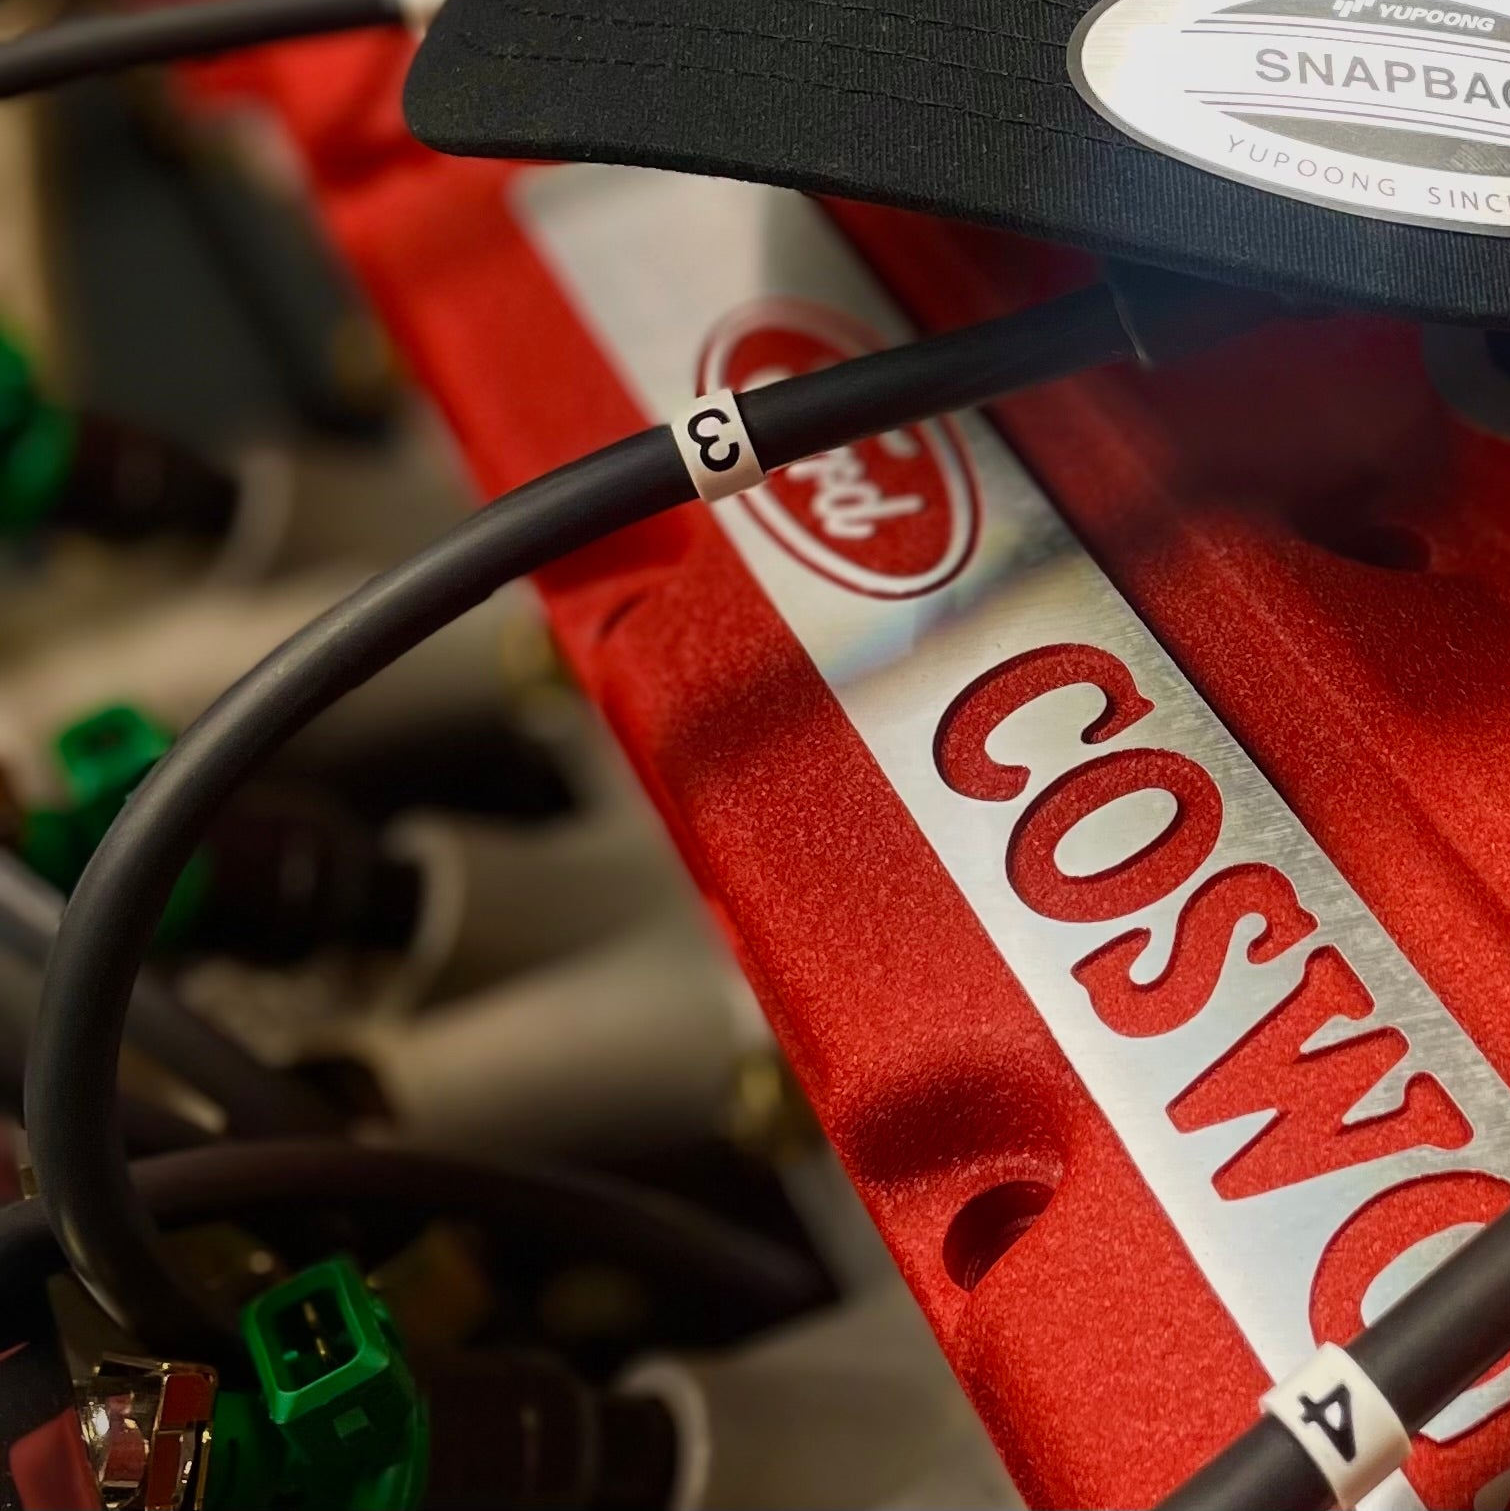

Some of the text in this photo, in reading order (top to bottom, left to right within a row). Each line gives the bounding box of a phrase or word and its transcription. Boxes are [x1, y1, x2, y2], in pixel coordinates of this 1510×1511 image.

[1379, 3, 1495, 31] YUPOONG
[1226, 134, 1397, 198] YUPOONG
[1299, 1381, 1358, 1463] 4
